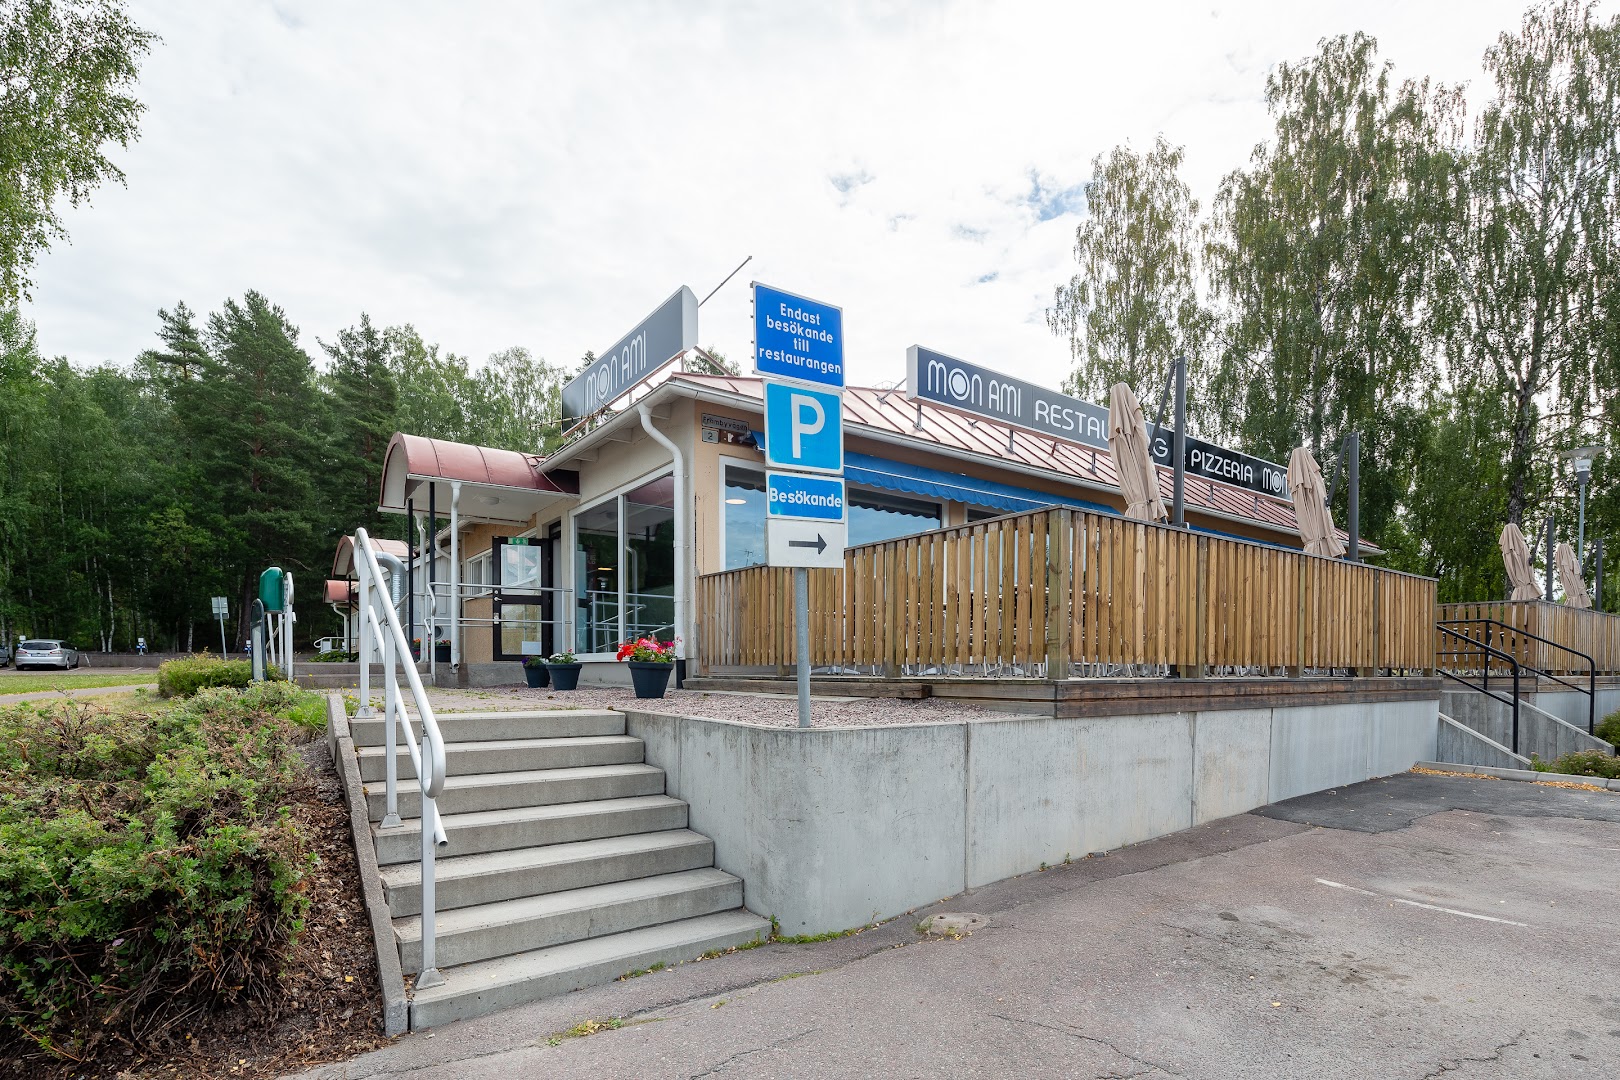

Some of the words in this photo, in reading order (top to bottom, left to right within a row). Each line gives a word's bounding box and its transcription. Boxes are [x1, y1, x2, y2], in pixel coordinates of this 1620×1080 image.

[780, 302, 820, 325] Endast
[766, 314, 833, 343] besökande
[621, 330, 646, 385] AMI
[793, 337, 809, 352] till
[759, 347, 841, 374] restaurangen
[790, 393, 826, 459] P
[927, 359, 983, 406] MON
[988, 379, 1021, 418] AMI
[1190, 449, 1253, 484] PIZZERIA
[707, 431, 713, 441] 2
[769, 487, 842, 508] Besökande
